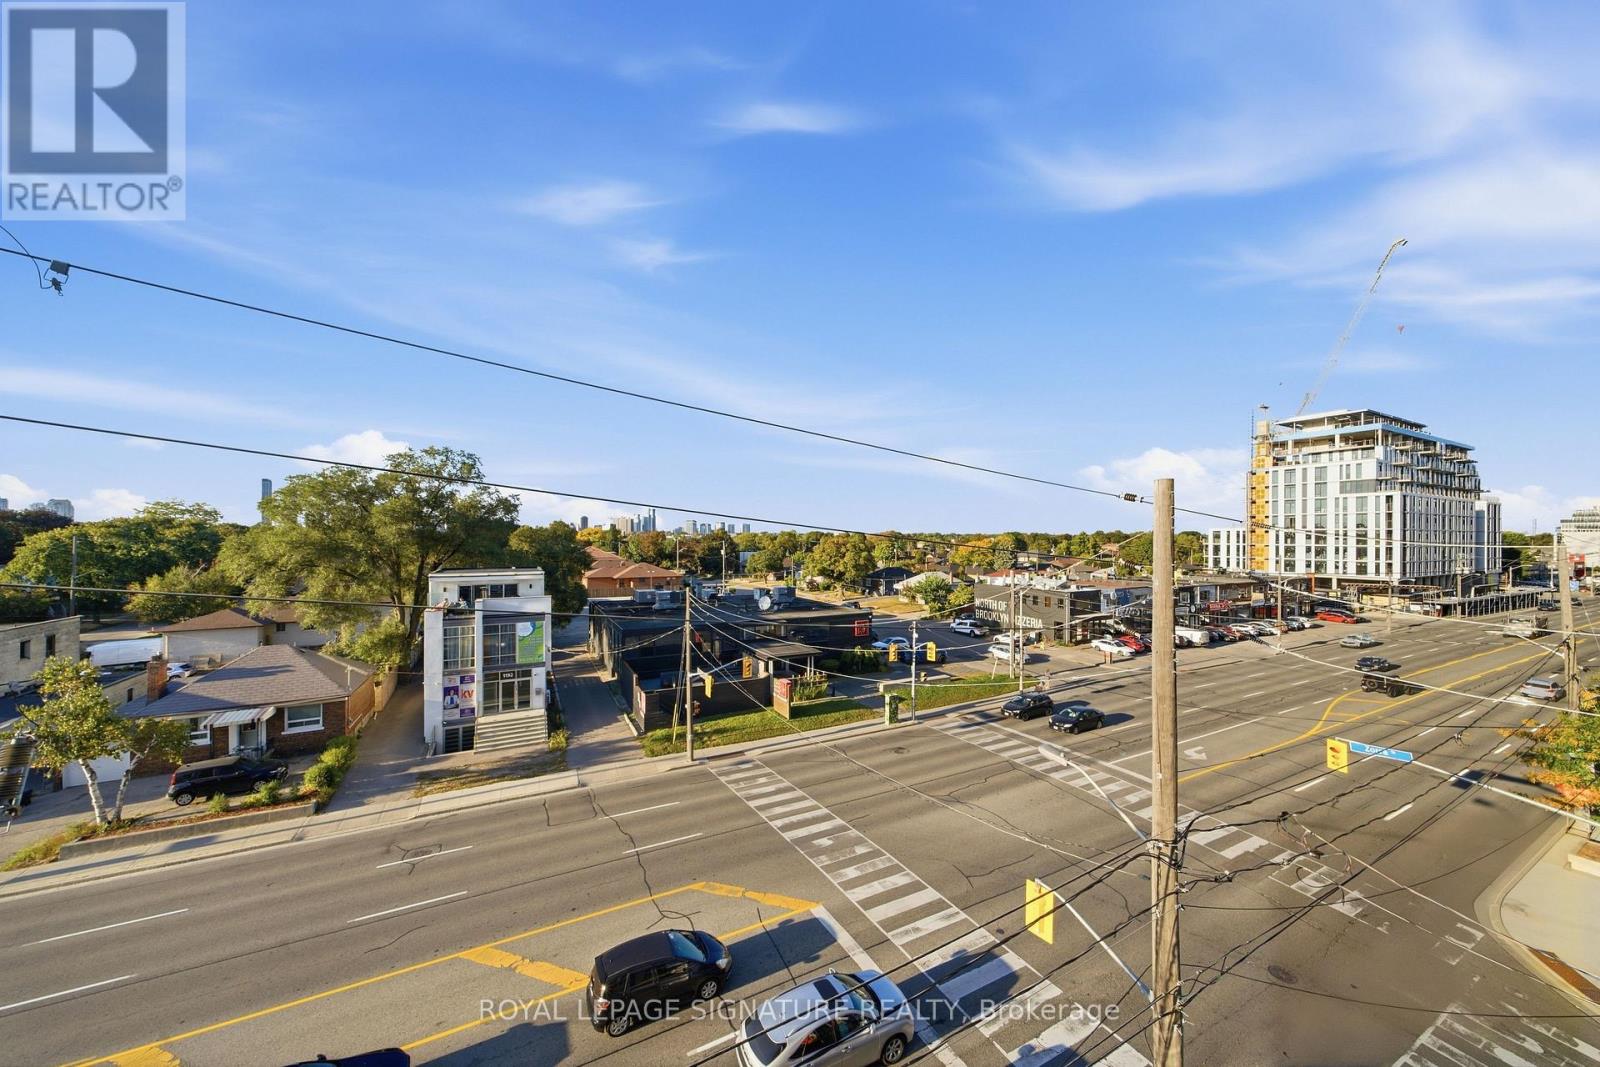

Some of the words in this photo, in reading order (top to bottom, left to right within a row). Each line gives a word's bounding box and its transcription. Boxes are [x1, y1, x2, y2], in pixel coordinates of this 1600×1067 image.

[975, 598, 997, 610] NORTH
[998, 600, 1008, 611] OF
[975, 609, 1009, 623] BROOKLYN
[1014, 615, 1043, 629] IZZERIA
